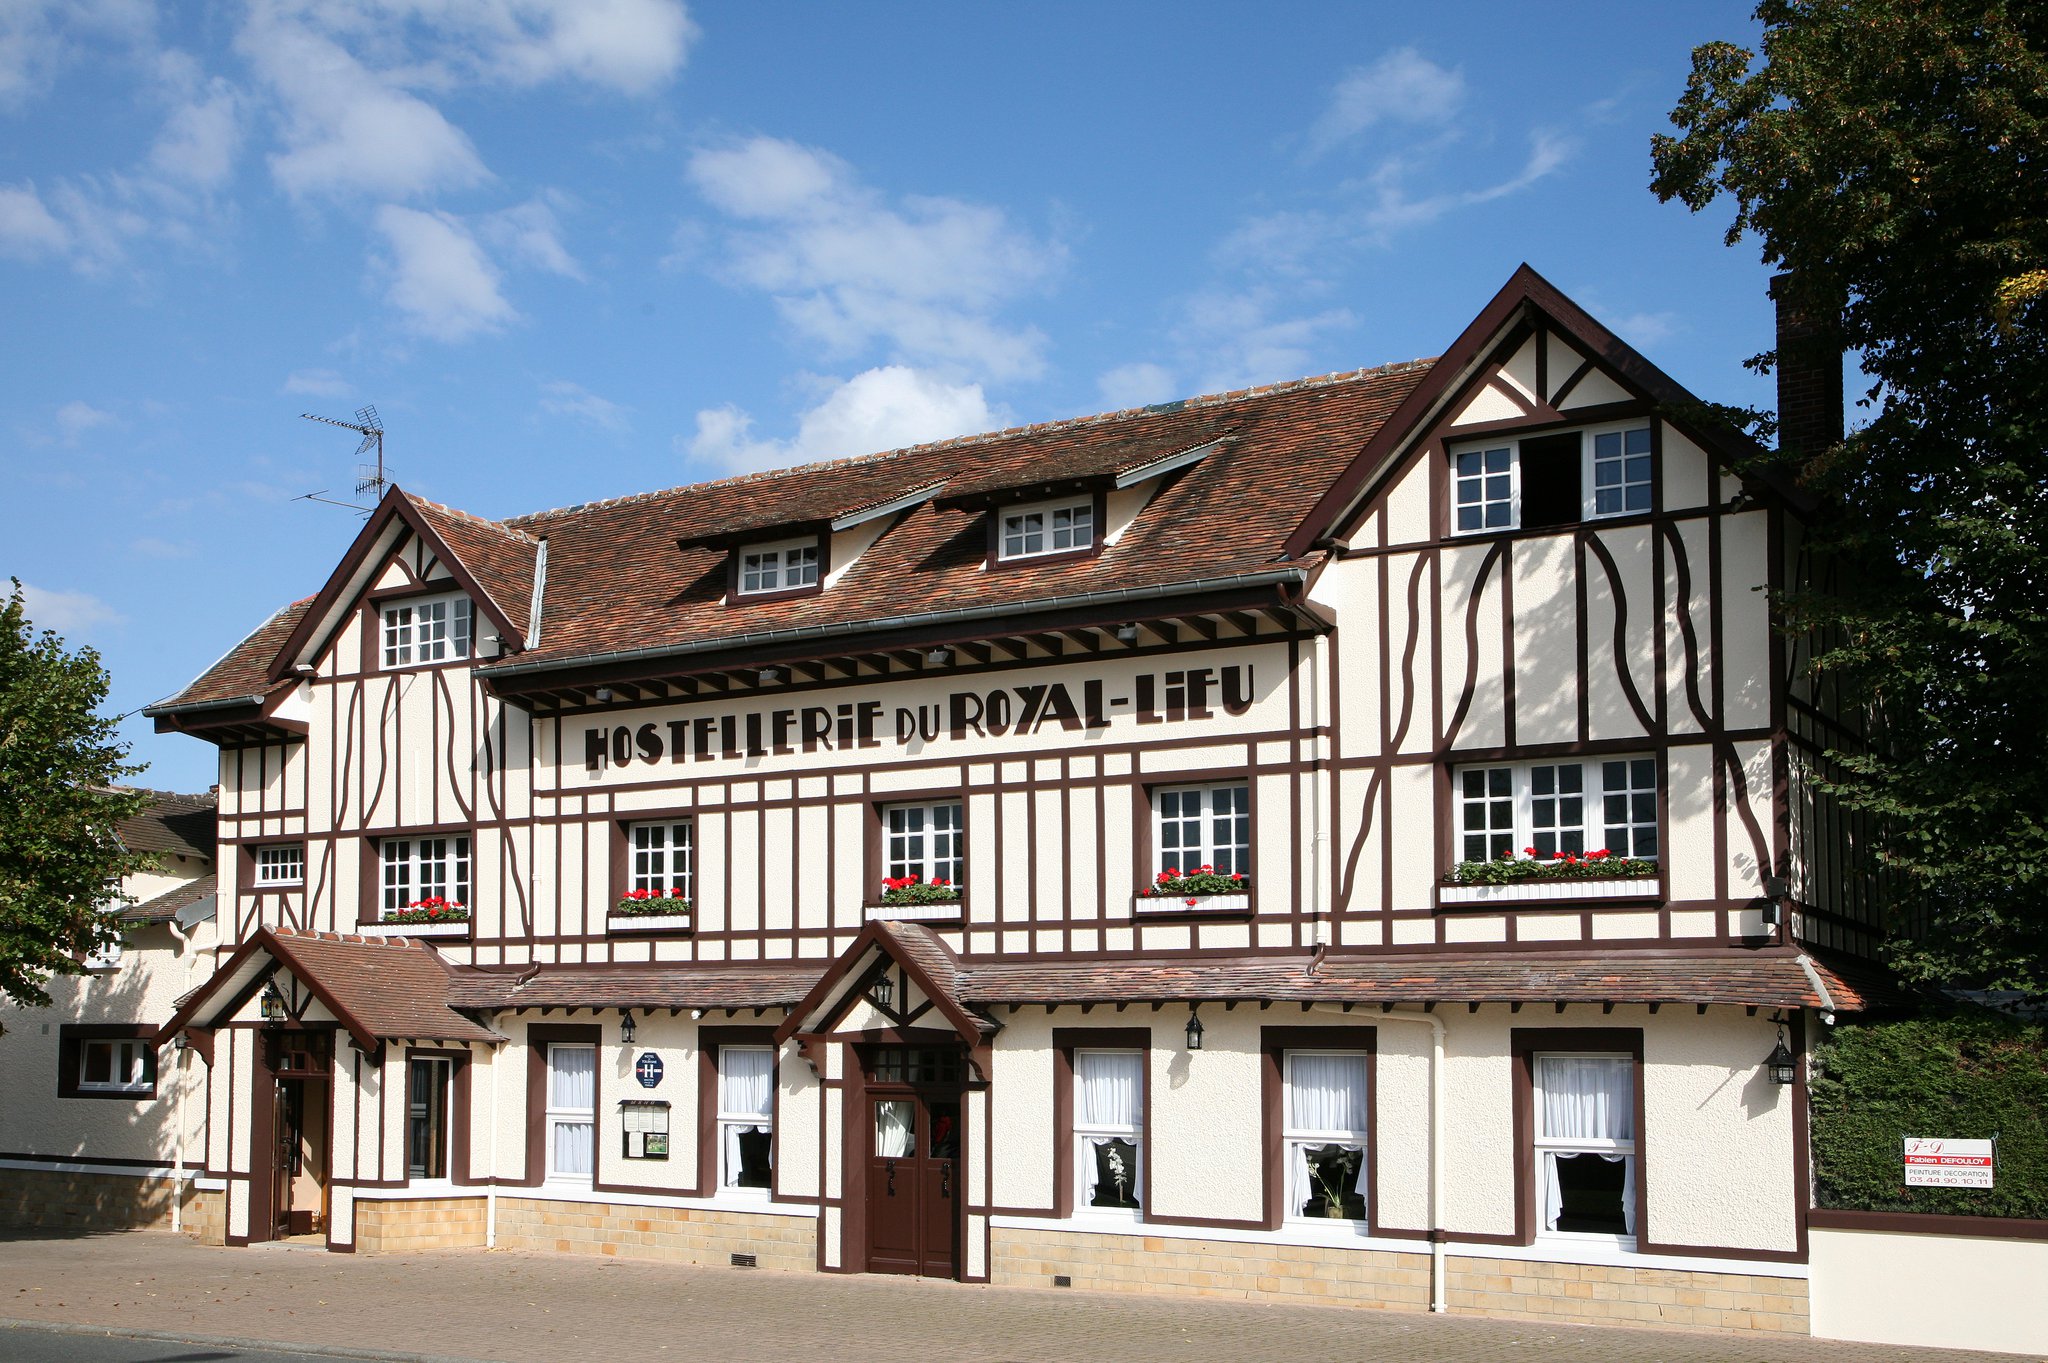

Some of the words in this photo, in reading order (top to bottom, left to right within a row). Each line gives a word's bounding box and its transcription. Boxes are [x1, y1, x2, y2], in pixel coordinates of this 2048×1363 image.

[896, 704, 940, 745] DU
[644, 1064, 654, 1078] H
[1940, 1157, 1984, 1165] DEFOULOY
[1944, 1170, 1989, 1178] DECORATION
[1909, 1177, 1988, 1185] 03.44.90.10.11
